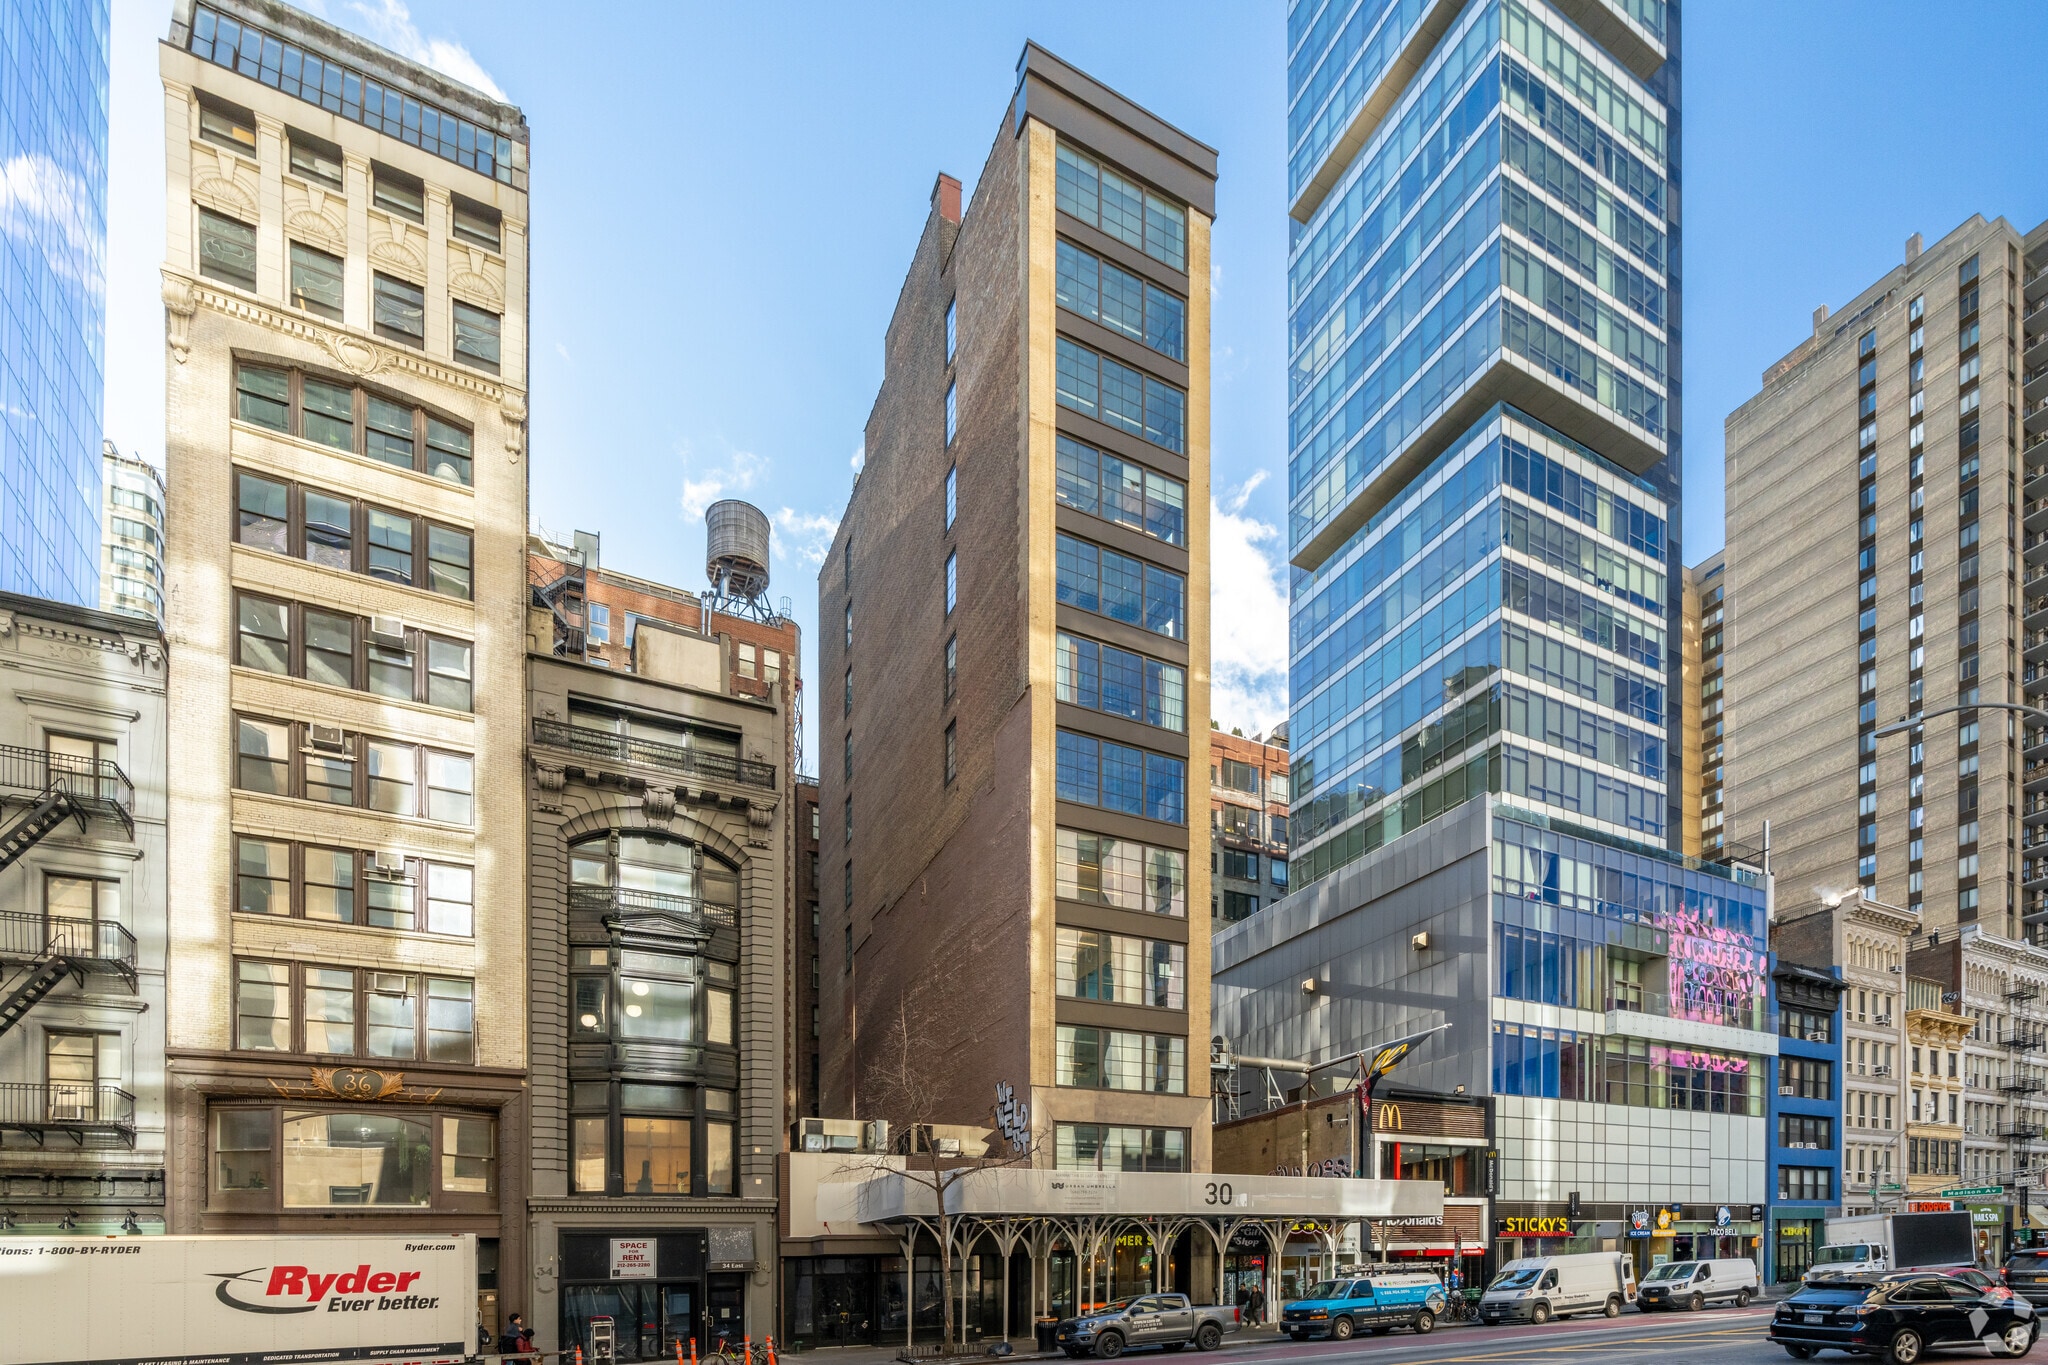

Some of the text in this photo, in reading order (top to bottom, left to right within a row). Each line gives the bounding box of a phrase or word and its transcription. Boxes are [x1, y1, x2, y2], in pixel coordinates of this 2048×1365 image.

[344, 1074, 371, 1091] 36
[1205, 1182, 1232, 1205] 30
[1974, 1213, 1998, 1221] NAILS SPA
[1506, 1217, 1567, 1232] STICKY'S
[1233, 1236, 1259, 1247] Shop
[38, 1246, 141, 1255] 1-800-BY-RYDER
[405, 1243, 456, 1252] Ryder.com
[537, 1267, 553, 1276] 34
[266, 1264, 421, 1302] Ryder
[327, 1295, 439, 1312] Ever better.
[293, 1352, 340, 1360] TRANSPORTATION
